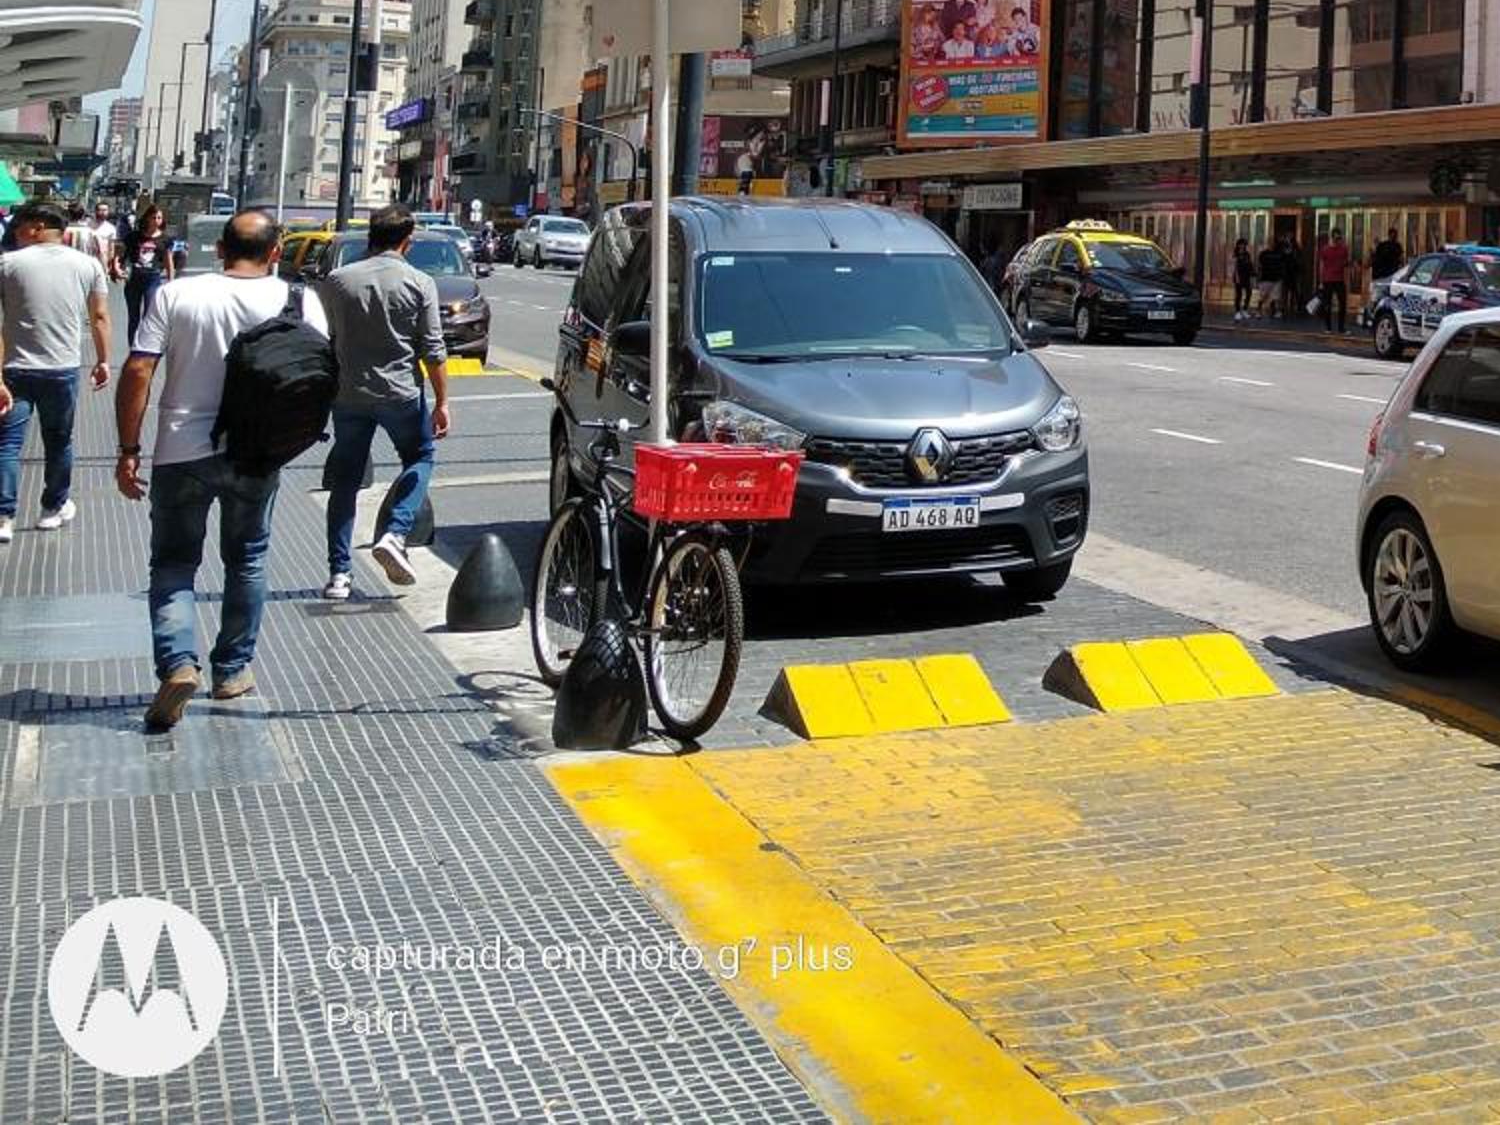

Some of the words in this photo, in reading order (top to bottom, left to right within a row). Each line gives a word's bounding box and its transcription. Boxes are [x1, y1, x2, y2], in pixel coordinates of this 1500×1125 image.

[888, 510, 910, 530] AD
[915, 508, 948, 527] 468
[953, 506, 976, 526] AQ
